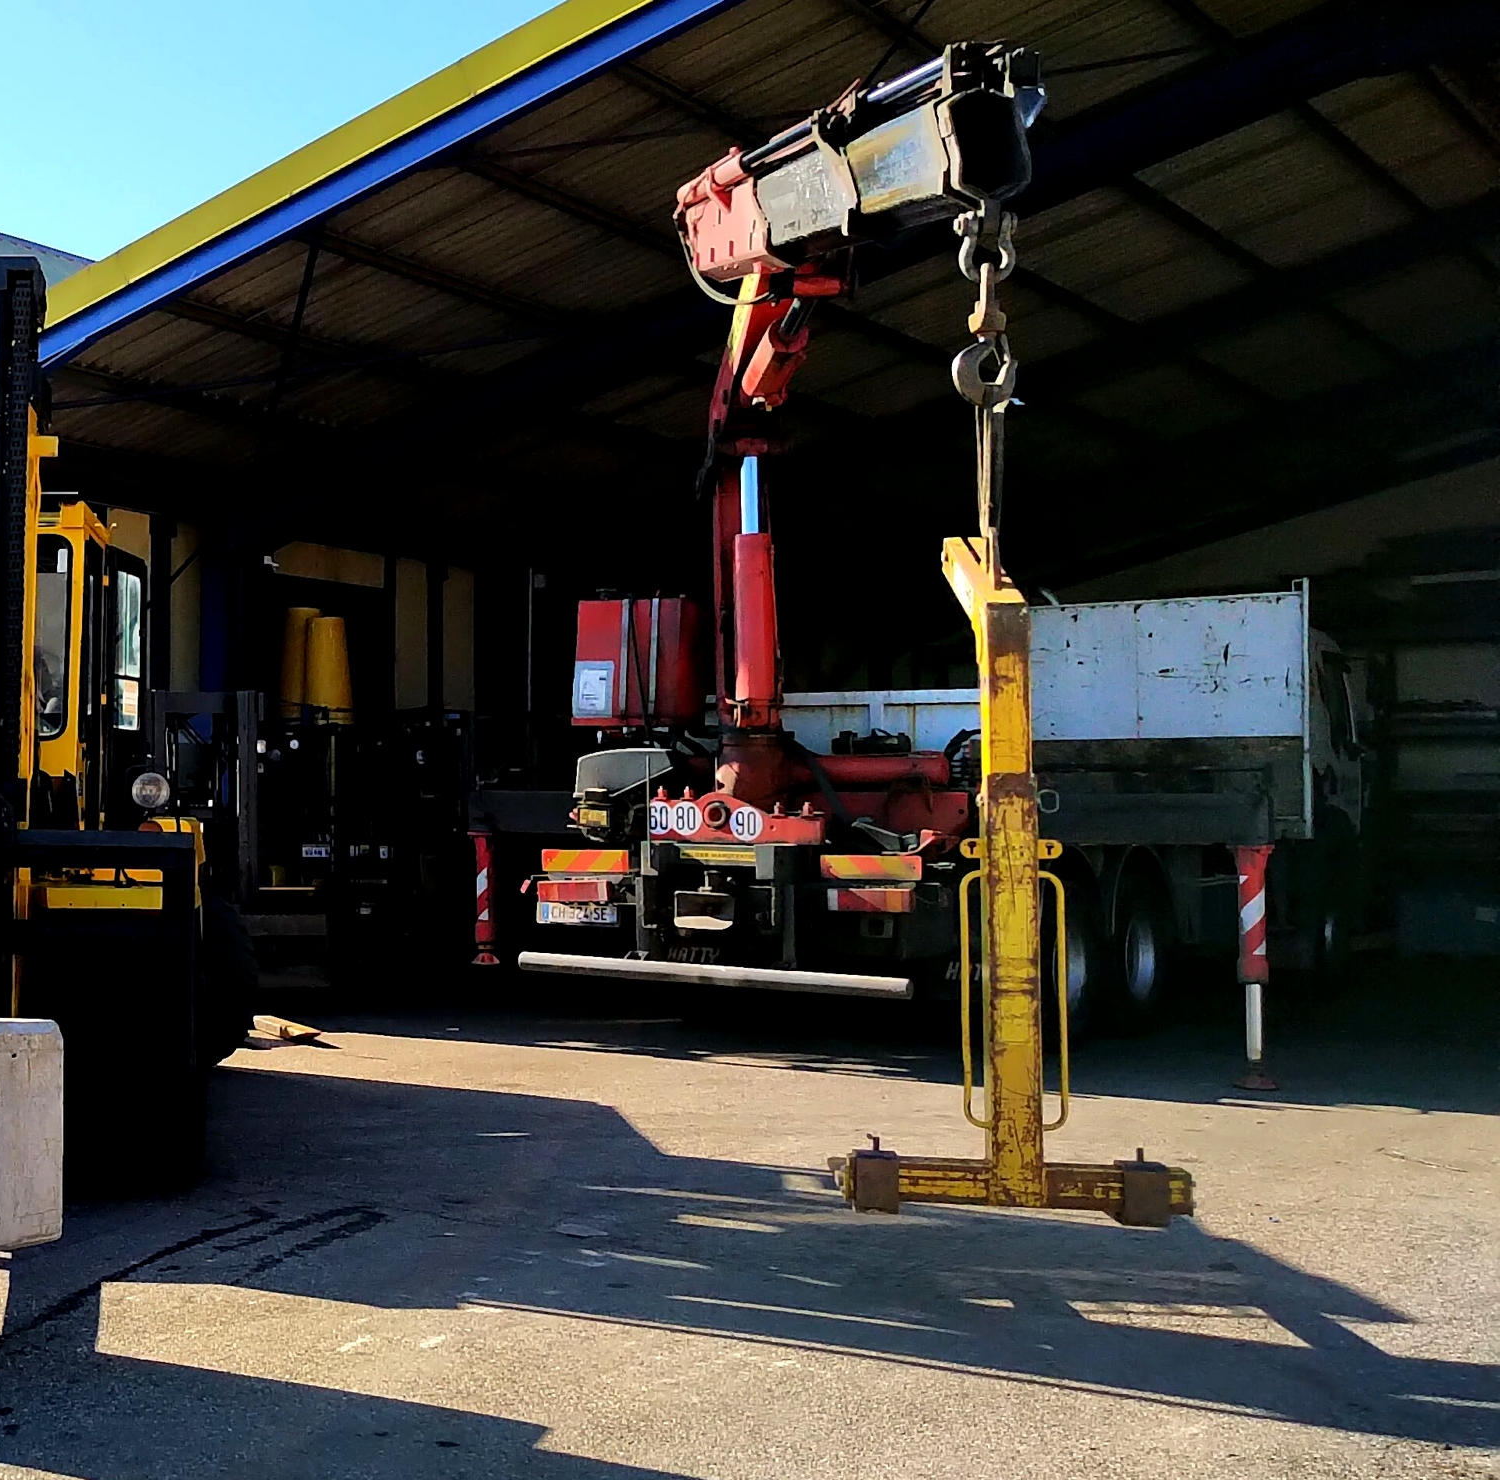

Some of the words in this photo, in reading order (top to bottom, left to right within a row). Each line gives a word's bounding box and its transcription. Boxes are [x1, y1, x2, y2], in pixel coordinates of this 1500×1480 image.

[649, 806, 669, 830] 60
[676, 806, 696, 830] 80
[735, 811, 757, 836] 90
